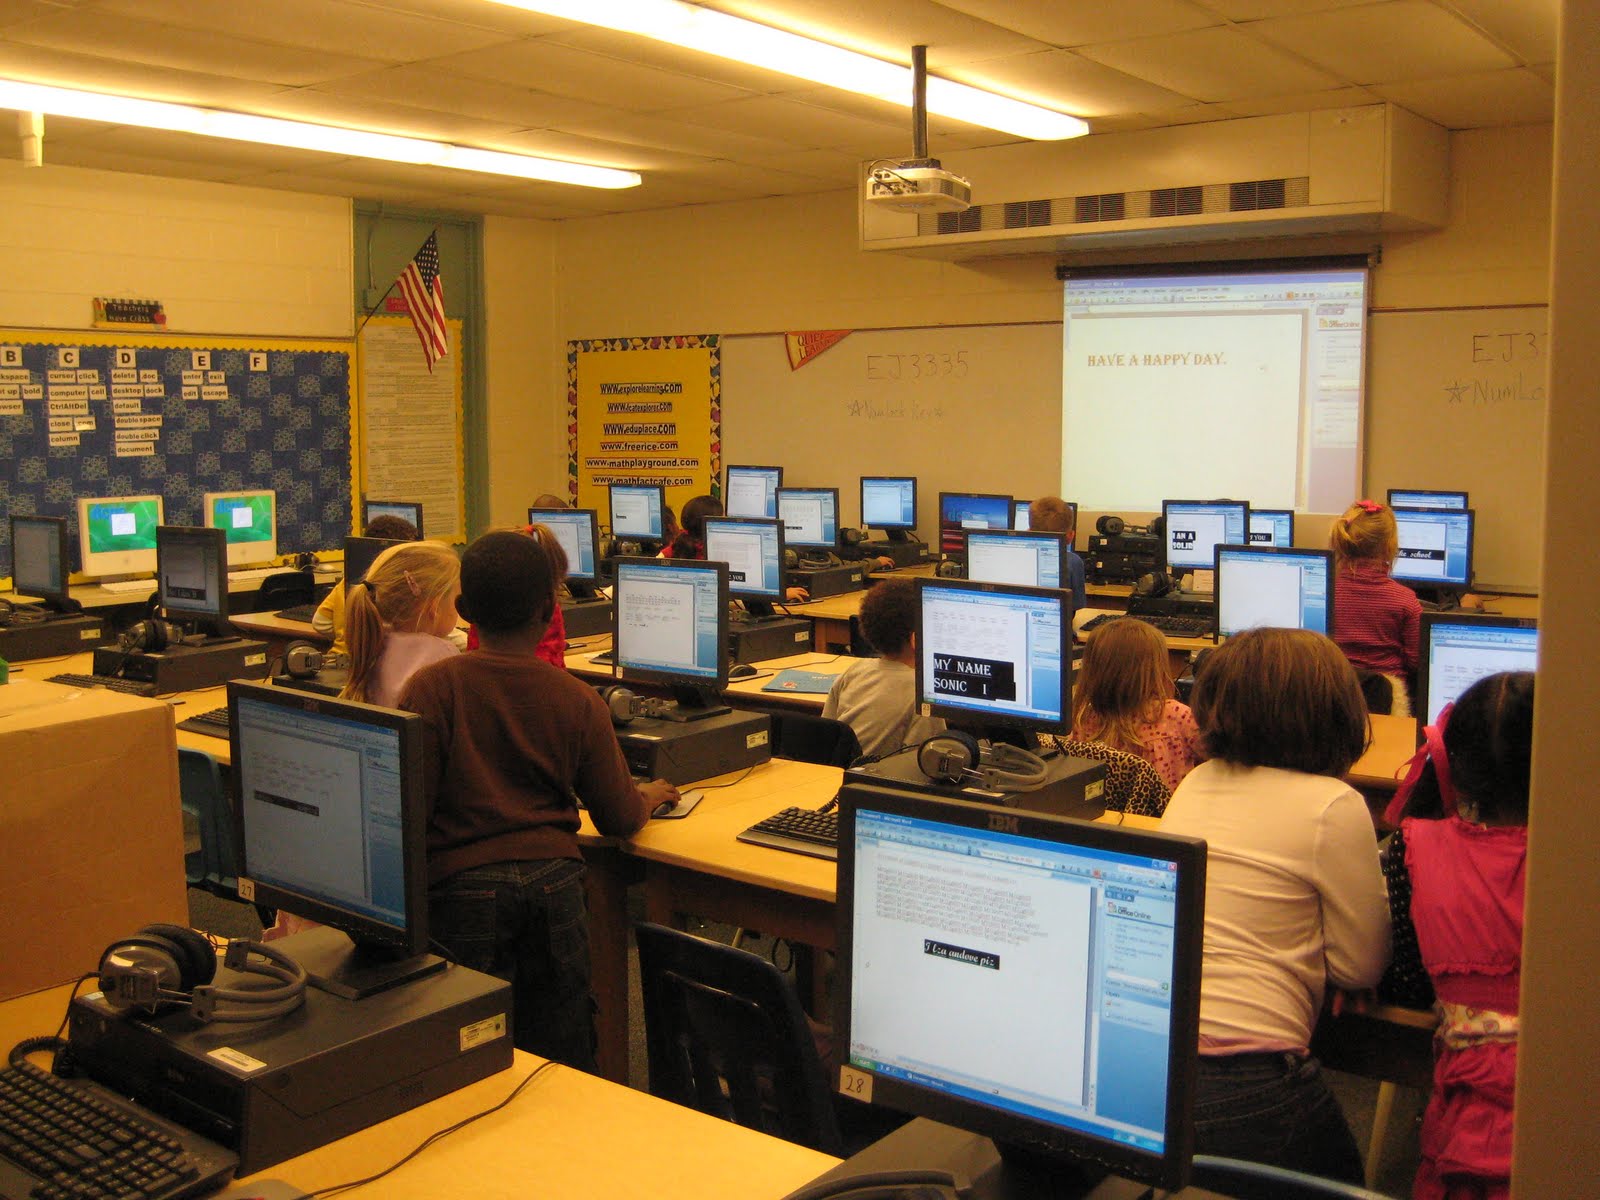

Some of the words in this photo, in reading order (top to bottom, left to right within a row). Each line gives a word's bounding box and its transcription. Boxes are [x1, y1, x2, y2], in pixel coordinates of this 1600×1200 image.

[1472, 333, 1549, 362] EJ3
[6, 350, 17, 363] B
[63, 351, 74, 364] C
[121, 352, 131, 364] D
[198, 355, 207, 367] E
[1087, 353, 1125, 367] HAVE
[1128, 354, 1139, 367] A
[1143, 352, 1191, 367] HAPPY
[1194, 352, 1227, 366] DAY.
[253, 356, 261, 368] F
[78, 372, 97, 380] click
[112, 372, 136, 380] delete
[23, 387, 41, 395] bold
[50, 389, 87, 397] computer
[90, 388, 105, 396] cell
[112, 387, 142, 396] desktop
[183, 389, 197, 397] edit
[203, 389, 227, 397] escape
[114, 401, 140, 409] default
[50, 420, 71, 428] close
[116, 416, 139, 424] double
[139, 415, 161, 424] space
[50, 434, 79, 443] column
[116, 432, 140, 440] double
[140, 431, 158, 439] click
[117, 445, 153, 453] document
[600, 442, 679, 451] www.freerice.com
[586, 459, 699, 469] www.mathplayground.com
[592, 476, 693, 486] www.mathfactcafe.com
[1410, 550, 1432, 559] school
[934, 658, 952, 671] MY
[957, 661, 993, 677] NAME
[934, 677, 968, 692] SONIC
[988, 814, 1020, 834] IBM
[241, 883, 253, 897] 27
[1134, 910, 1152, 920] Online
[845, 1074, 865, 1094] 28
